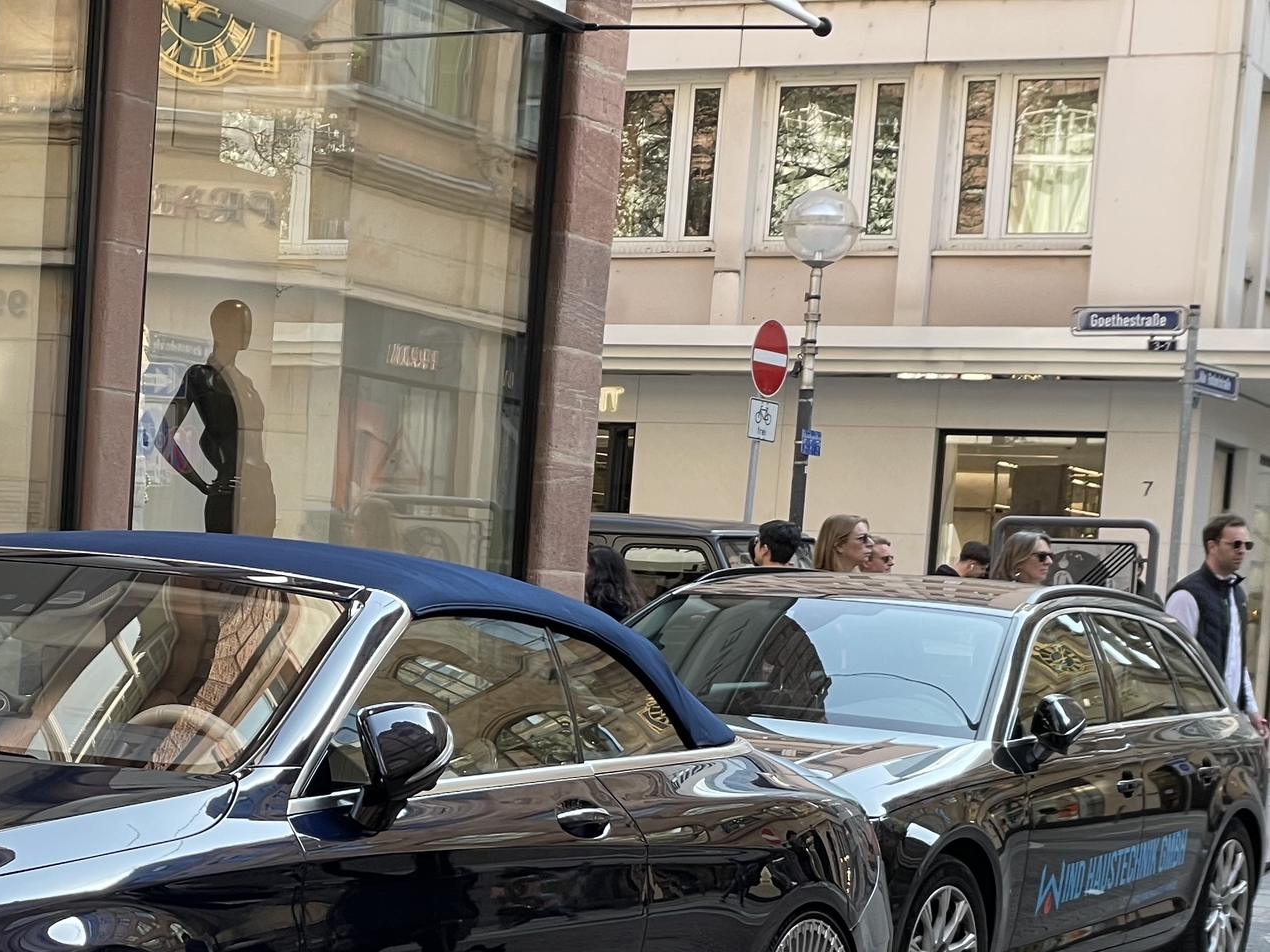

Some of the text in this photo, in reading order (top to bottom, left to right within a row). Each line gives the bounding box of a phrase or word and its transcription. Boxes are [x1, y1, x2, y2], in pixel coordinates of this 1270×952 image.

[1090, 312, 1167, 328] Goethestraße
[1142, 481, 1154, 497] 7
[1035, 860, 1086, 916] WIND
[1086, 838, 1160, 891] HAUSTECHNIK
